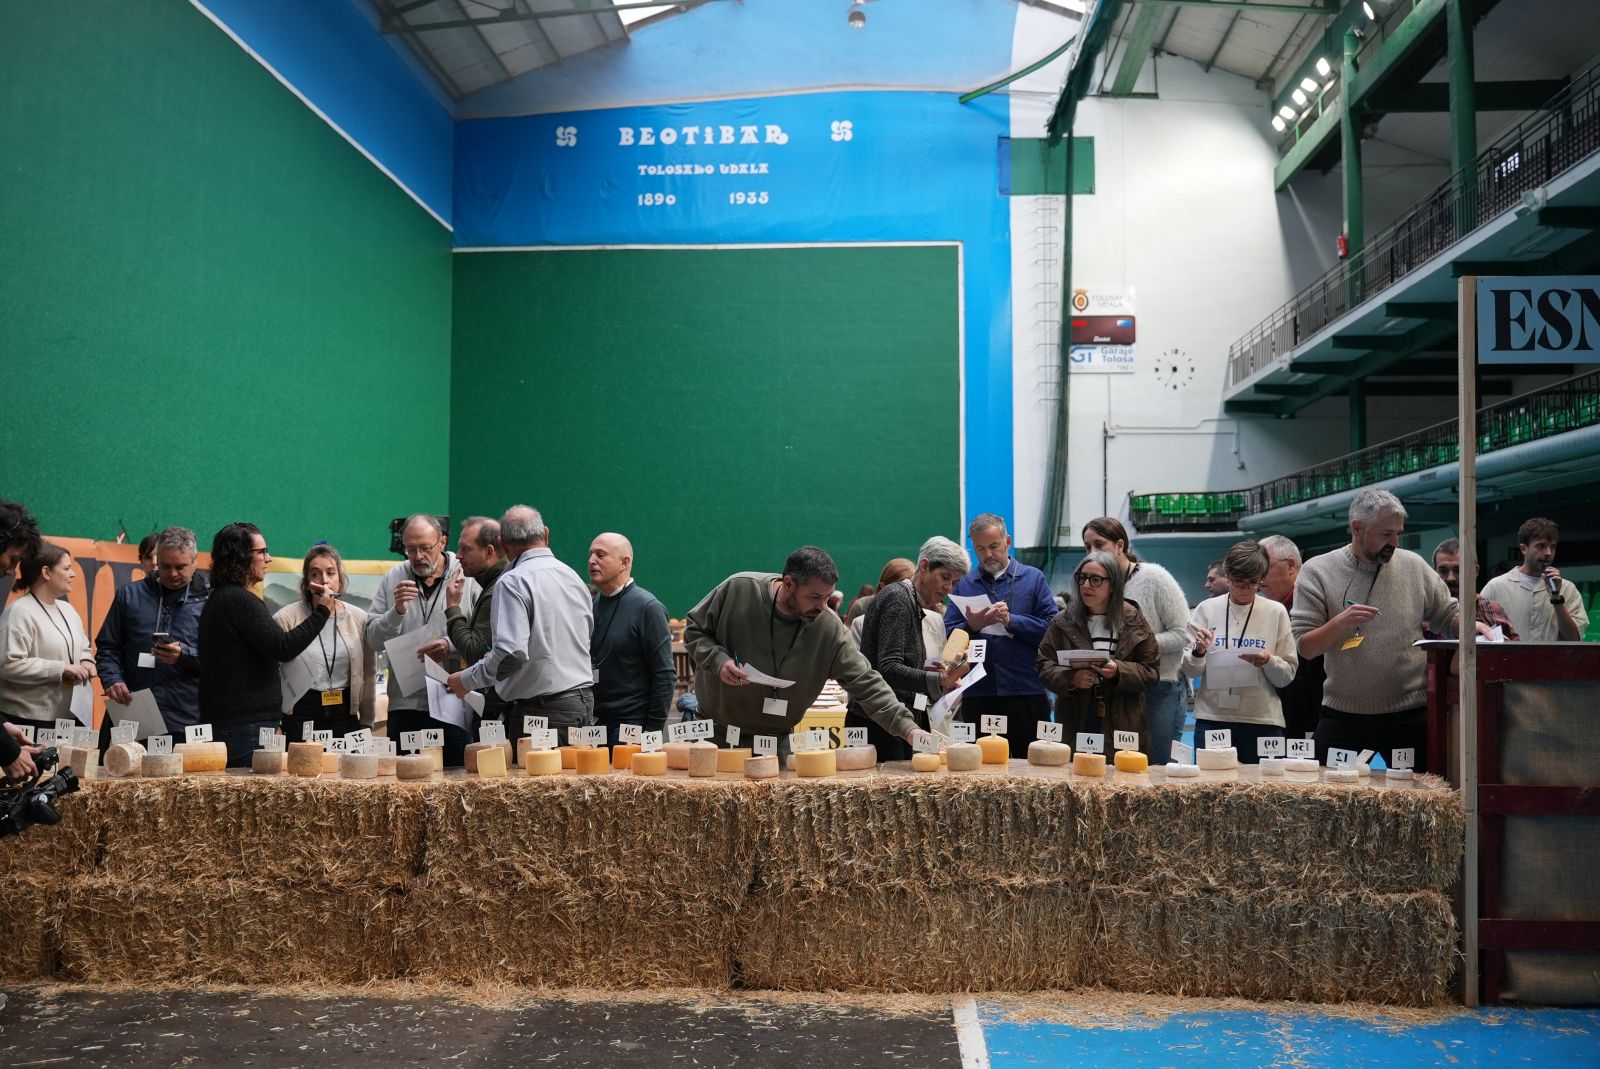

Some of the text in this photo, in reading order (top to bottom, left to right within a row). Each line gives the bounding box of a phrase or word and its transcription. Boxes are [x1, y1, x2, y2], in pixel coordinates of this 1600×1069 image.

[719, 163, 769, 174] UDALA
[638, 192, 769, 206] 1890 1935
[1100, 346, 1134, 356] Garaje
[1101, 355, 1134, 363] Tolosa
[1232, 637, 1266, 649] TROPEZ
[1086, 736, 1094, 745] 6
[1118, 733, 1135, 743] 160
